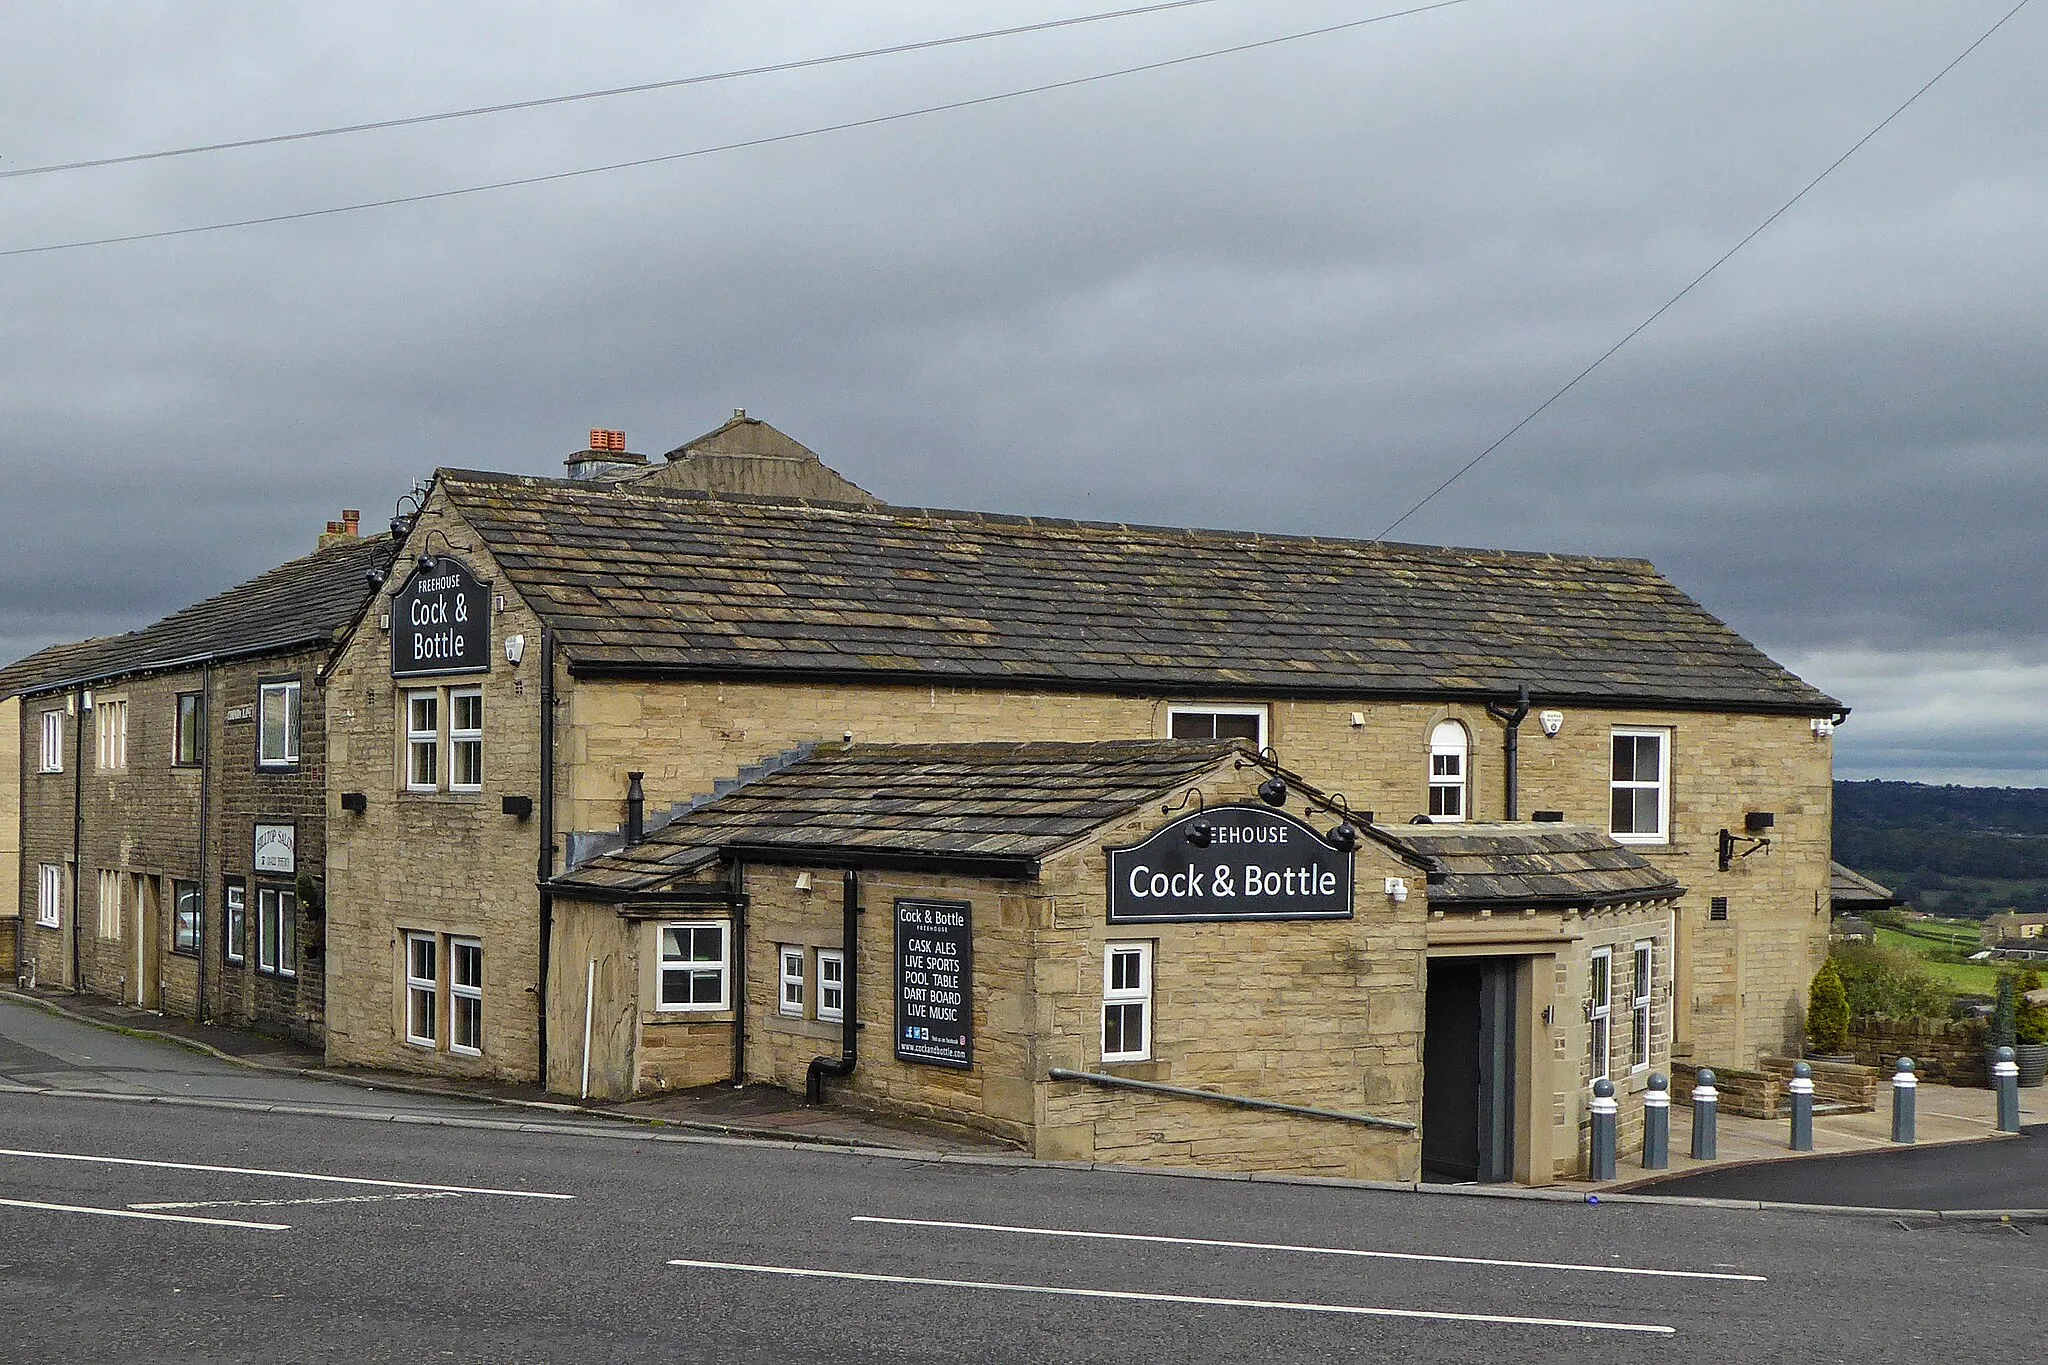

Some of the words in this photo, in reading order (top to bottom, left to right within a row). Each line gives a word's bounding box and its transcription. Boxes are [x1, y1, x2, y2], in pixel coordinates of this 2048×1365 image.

[418, 574, 460, 593] FREEHOUSE
[411, 593, 448, 626] Cock
[455, 592, 468, 622] &
[414, 627, 464, 660] Bottle
[1187, 826, 1288, 844] EEHOUSE
[1129, 863, 1204, 898] Cock
[1211, 864, 1236, 897] &
[1245, 862, 1336, 896] Bottle
[900, 908, 922, 923] Cock
[924, 909, 933, 924] &
[935, 911, 964, 927] Bottle
[908, 938, 932, 953] CASK
[934, 941, 957, 956] ALES
[905, 954, 924, 969] LIVE
[926, 956, 960, 973] SPORTS
[905, 970, 930, 986] POOL
[932, 973, 959, 989] TABLE
[903, 986, 927, 1002] DART
[930, 989, 962, 1006] BOARD
[907, 1003, 927, 1018] LIVE
[929, 1005, 958, 1022] MUSIC
